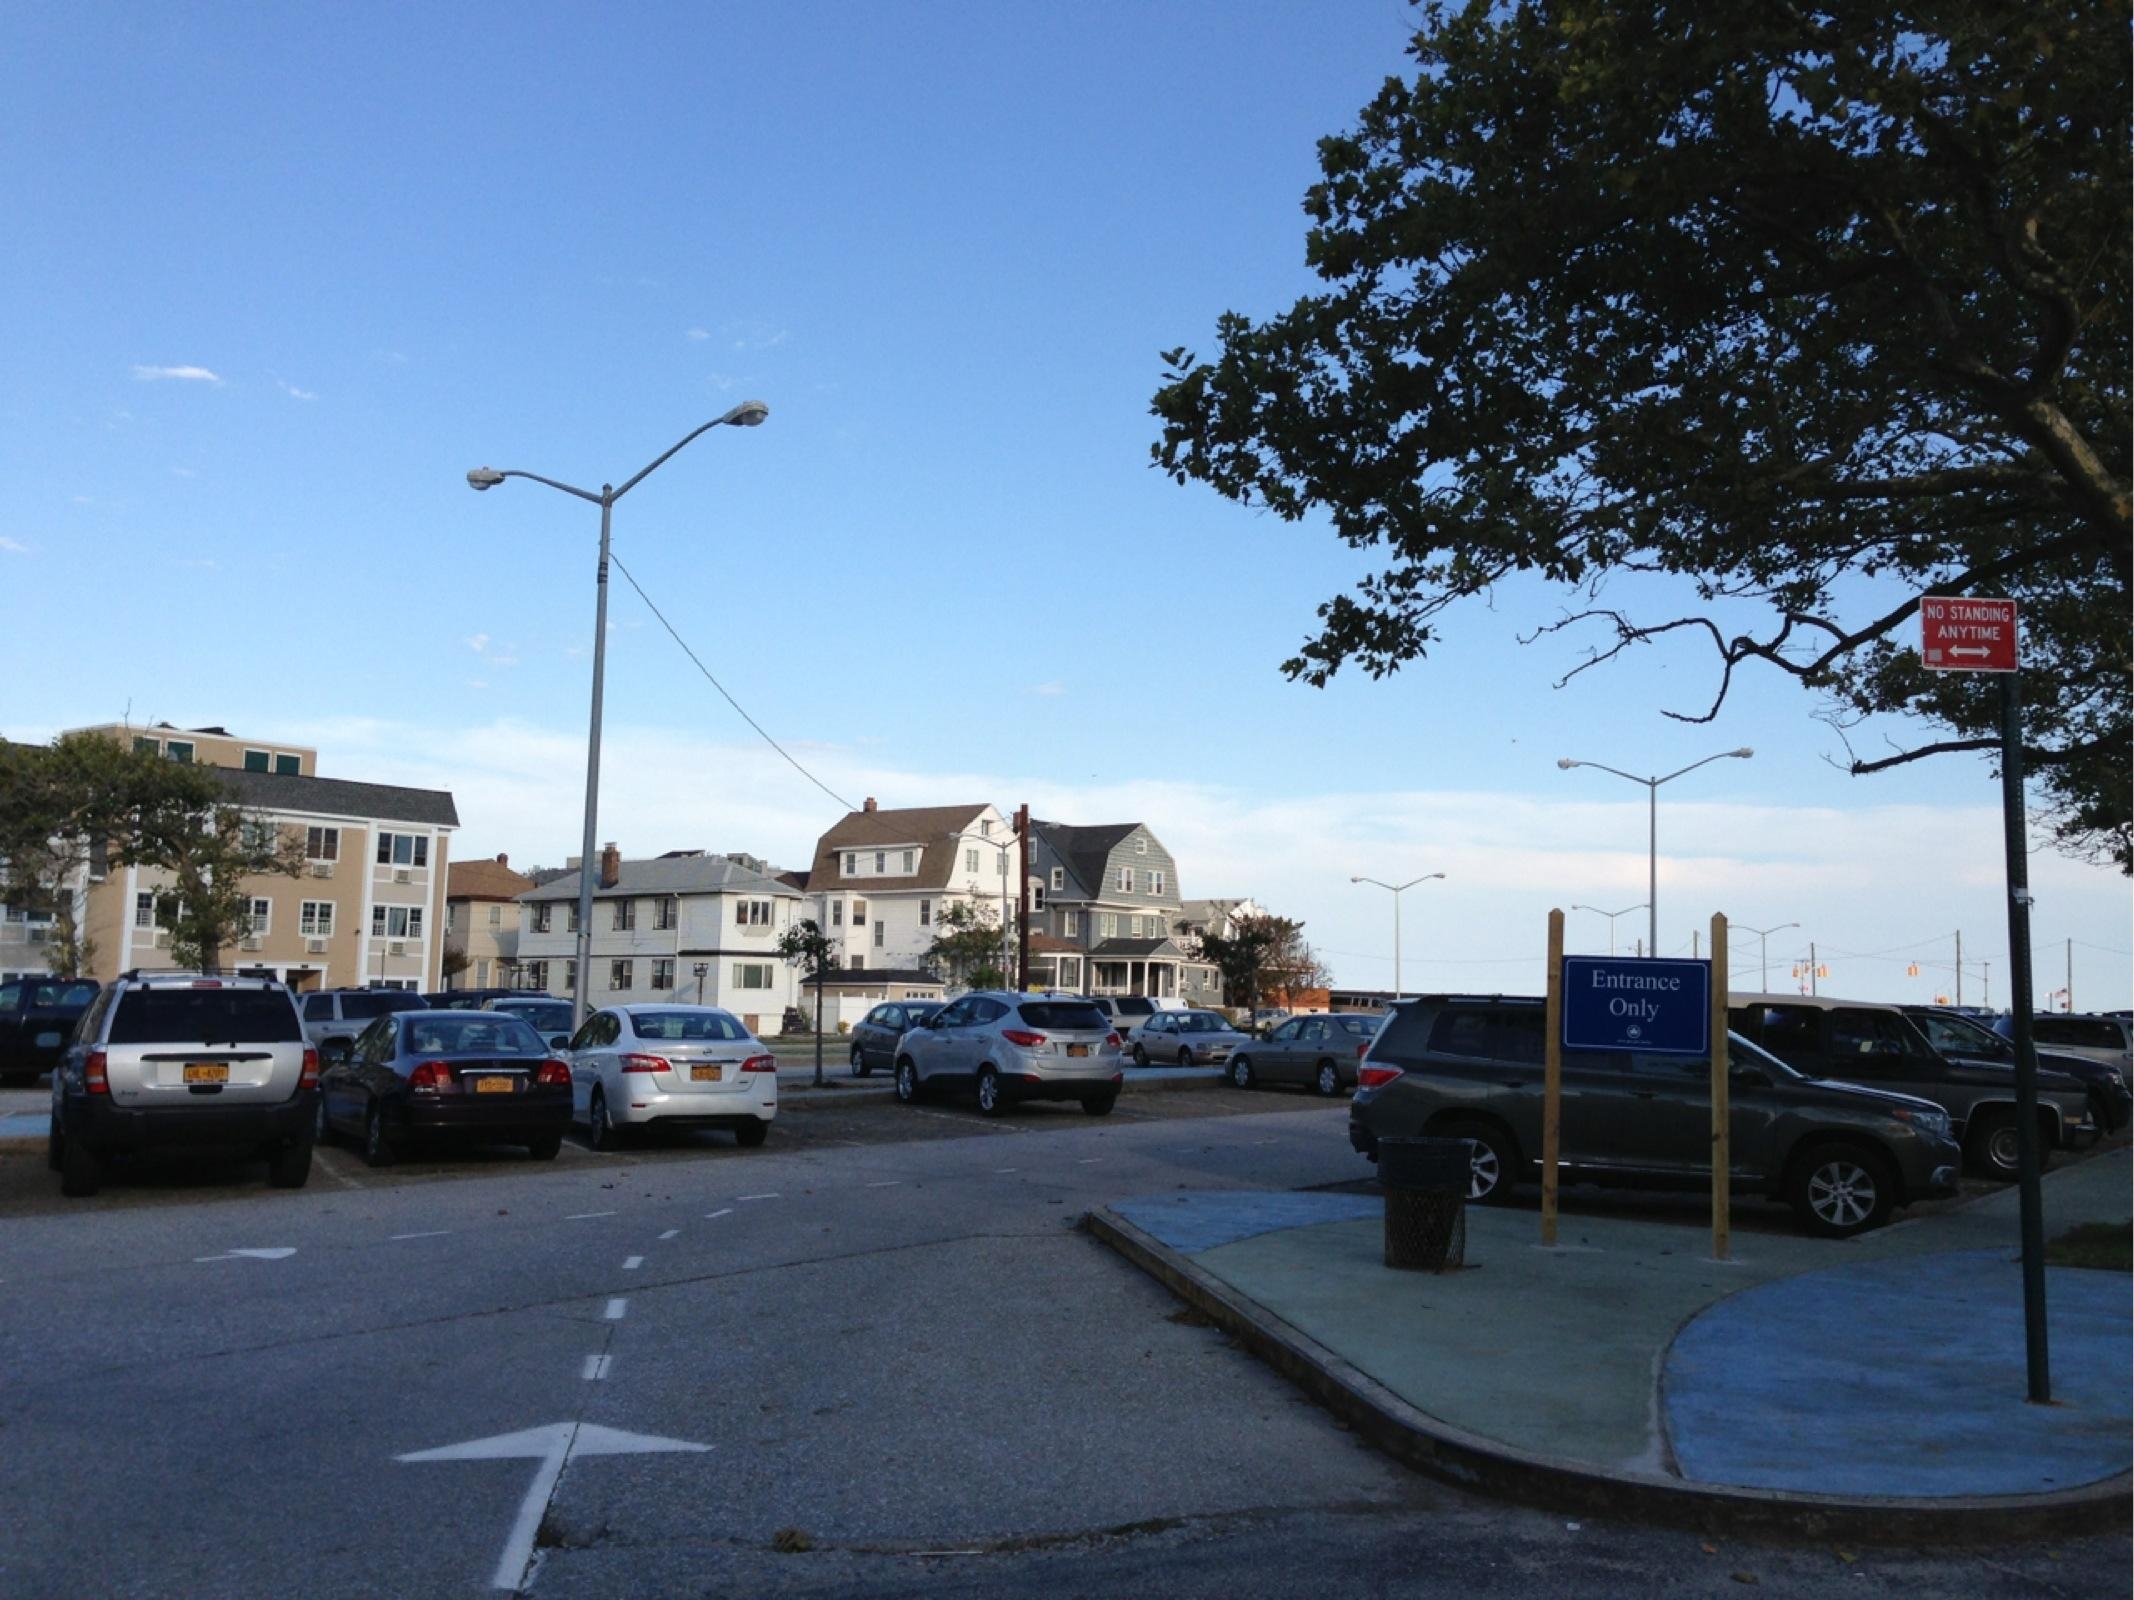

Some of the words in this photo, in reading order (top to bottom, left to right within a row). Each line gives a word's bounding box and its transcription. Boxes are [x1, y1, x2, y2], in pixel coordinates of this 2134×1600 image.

[1927, 604, 1944, 619] NO
[1950, 606, 2009, 623] STANDING
[1937, 624, 2001, 641] ANYTIME
[1591, 969, 1681, 991] Entrance
[1609, 997, 1661, 1023] Only
